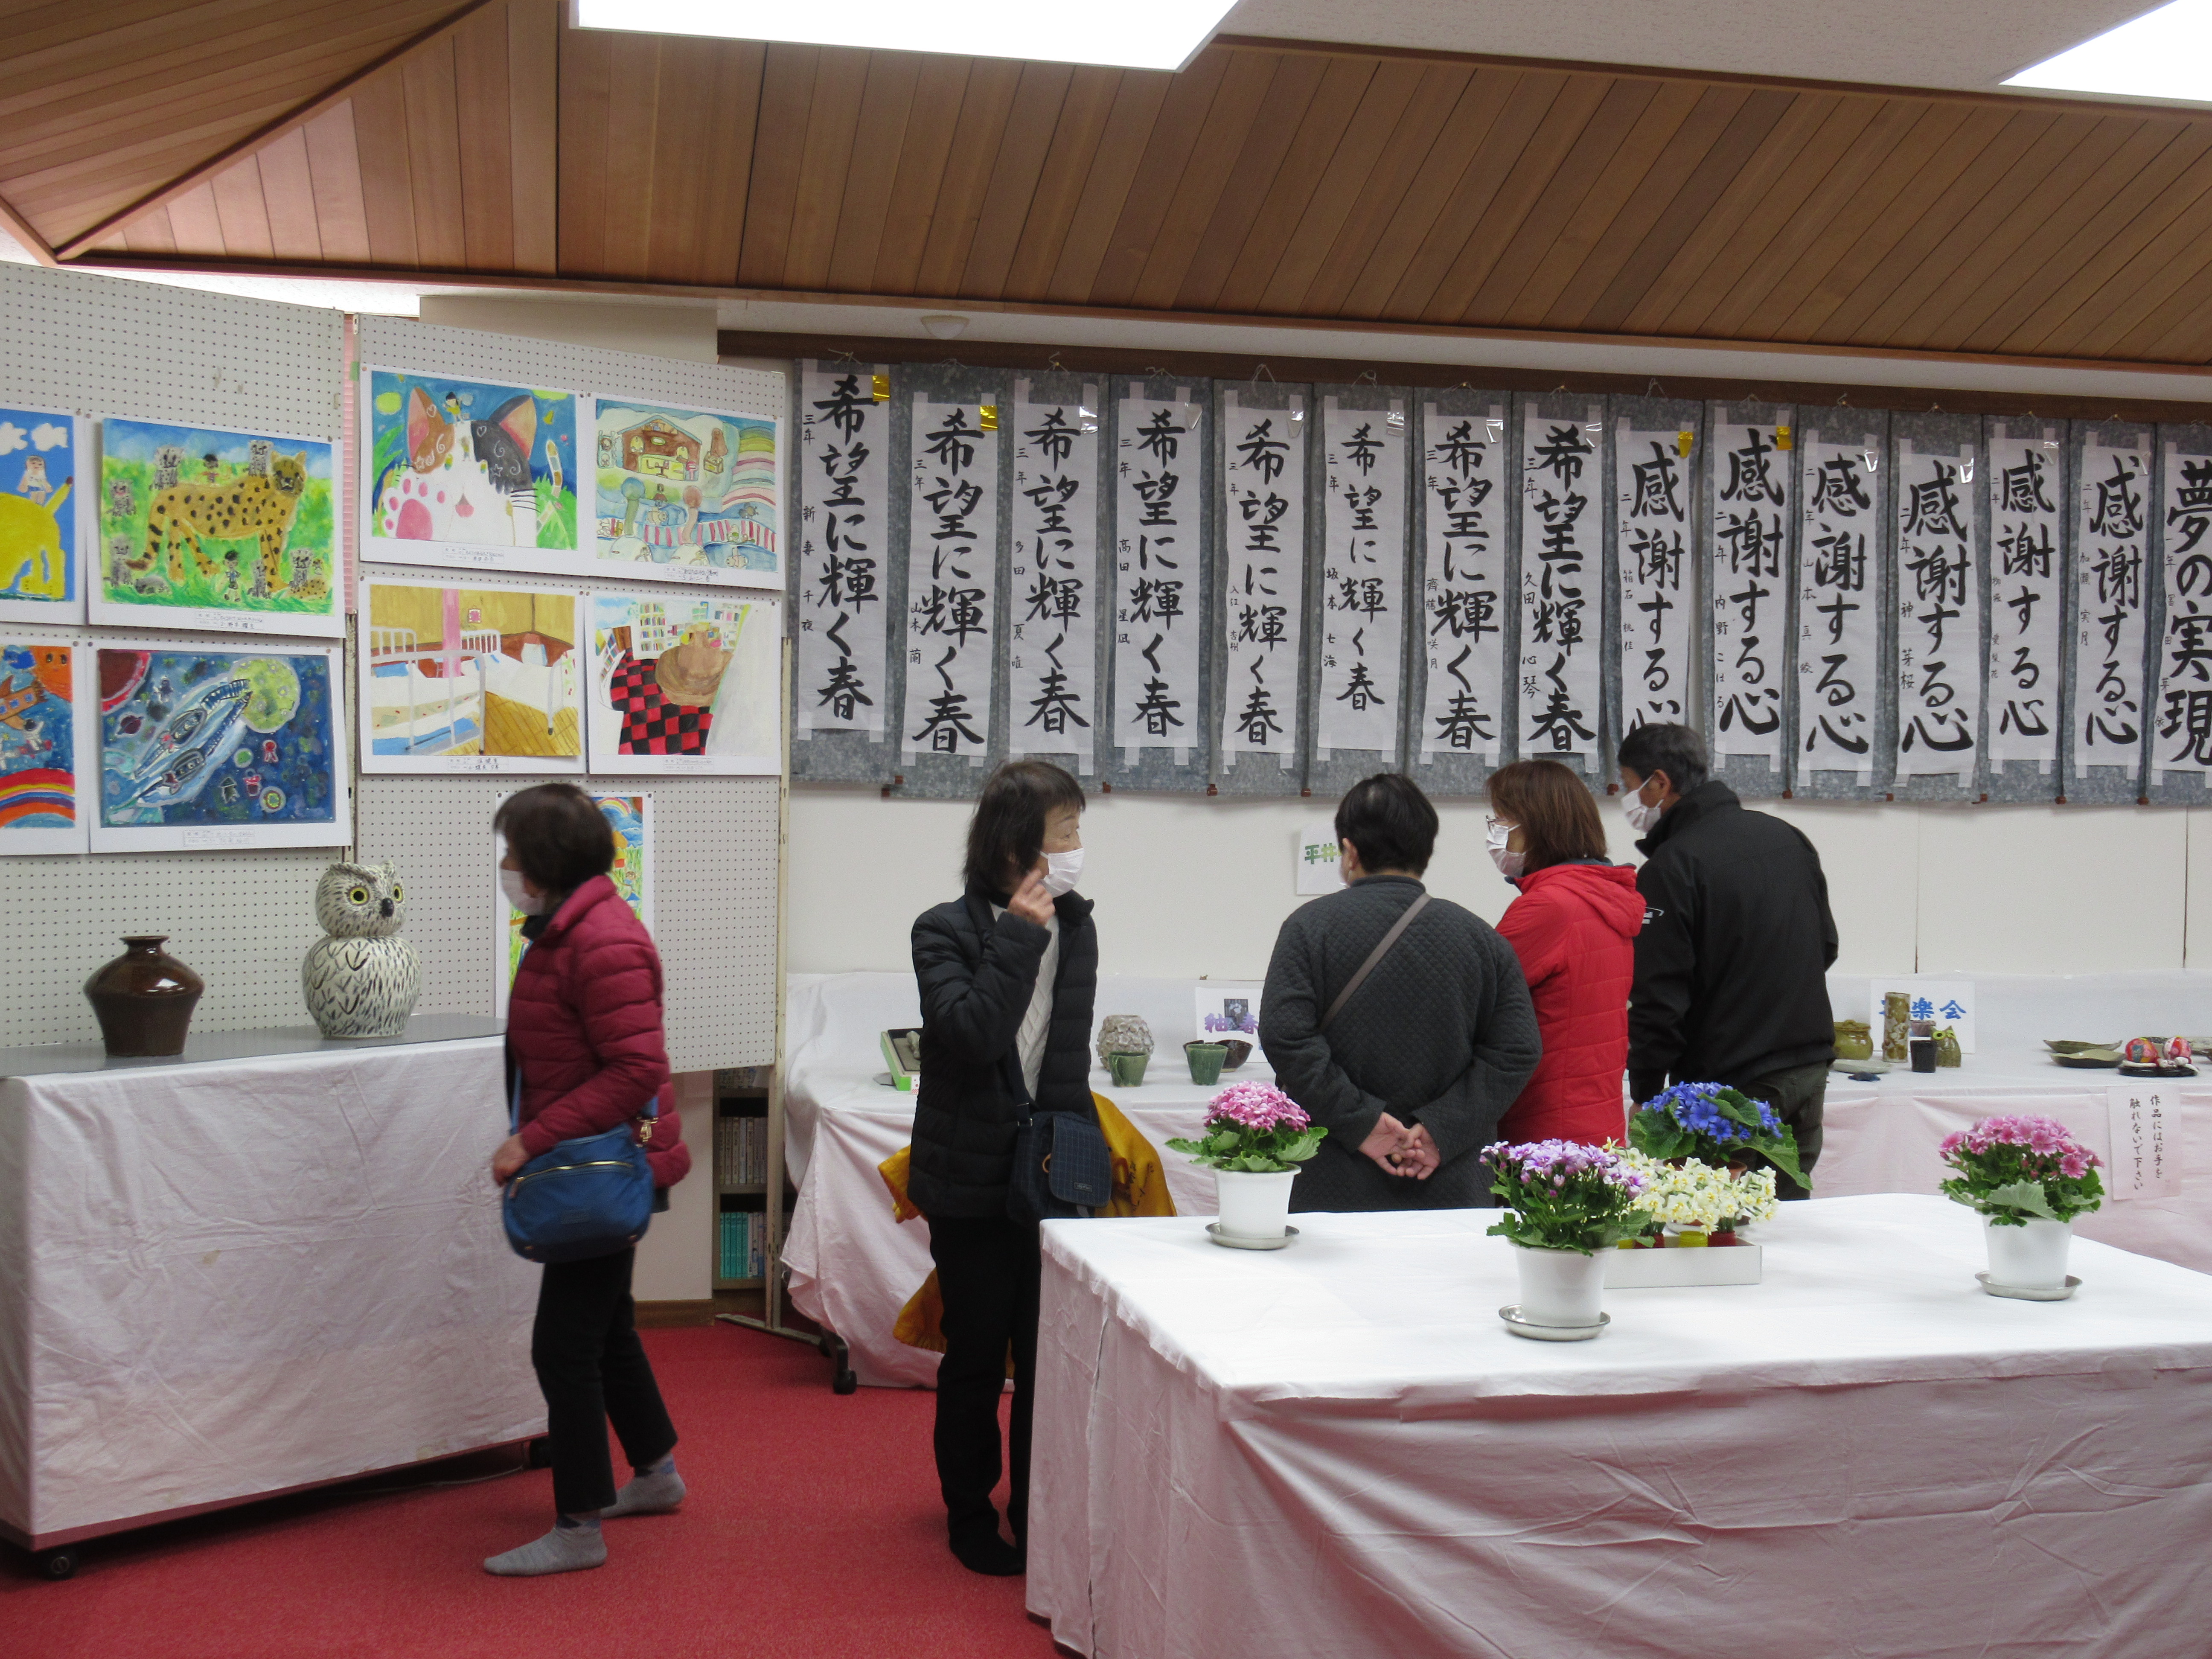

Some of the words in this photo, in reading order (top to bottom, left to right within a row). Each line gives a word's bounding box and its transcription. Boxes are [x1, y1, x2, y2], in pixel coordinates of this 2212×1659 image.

[803, 414, 815, 445] 三年
[1119, 439, 1132, 478] 三年
[914, 460, 927, 490] 三年
[1016, 448, 1029, 484] 三年
[1229, 463, 1238, 495] 三年
[1328, 454, 1339, 492] 三年
[1426, 450, 1438, 490] 三年
[1525, 458, 1537, 499] 三年
[1805, 469, 1815, 525] 二年
[1992, 478, 2000, 503] 二年
[2083, 484, 2092, 512] 二年
[813, 374, 879, 720] 希望に輝く春
[1621, 494, 1632, 536] 二年
[1715, 512, 1726, 562] 二年
[1901, 508, 1910, 552] 二年
[913, 408, 987, 753] 希望に輝く春
[1023, 407, 1089, 734] 希望に輝く春
[1130, 409, 1185, 736] 希望に輝く春
[1234, 419, 1289, 745] 希望に輝く春
[1337, 423, 1387, 710] 希望に輝く春
[1431, 421, 1499, 749] 希望に輝く春
[1525, 424, 1596, 751] 希望に輝く春
[1717, 428, 1784, 735] 感謝する心
[2165, 538, 2175, 569] 一年
[1324, 568, 1338, 667] 坂本七海
[1807, 453, 1870, 754] 感謝する心
[1902, 460, 1973, 752] 感謝する心
[1997, 449, 2055, 736] 感謝する心
[2086, 455, 2143, 745] 感謝する心
[1715, 595, 1728, 709] 内野こはる
[1304, 843, 1342, 864] 平井
[1879, 997, 1967, 1020] 楽会
[2129, 1098, 2143, 1190] 触れないで下さい
[2150, 1094, 2163, 1178] 作品にはお手を
